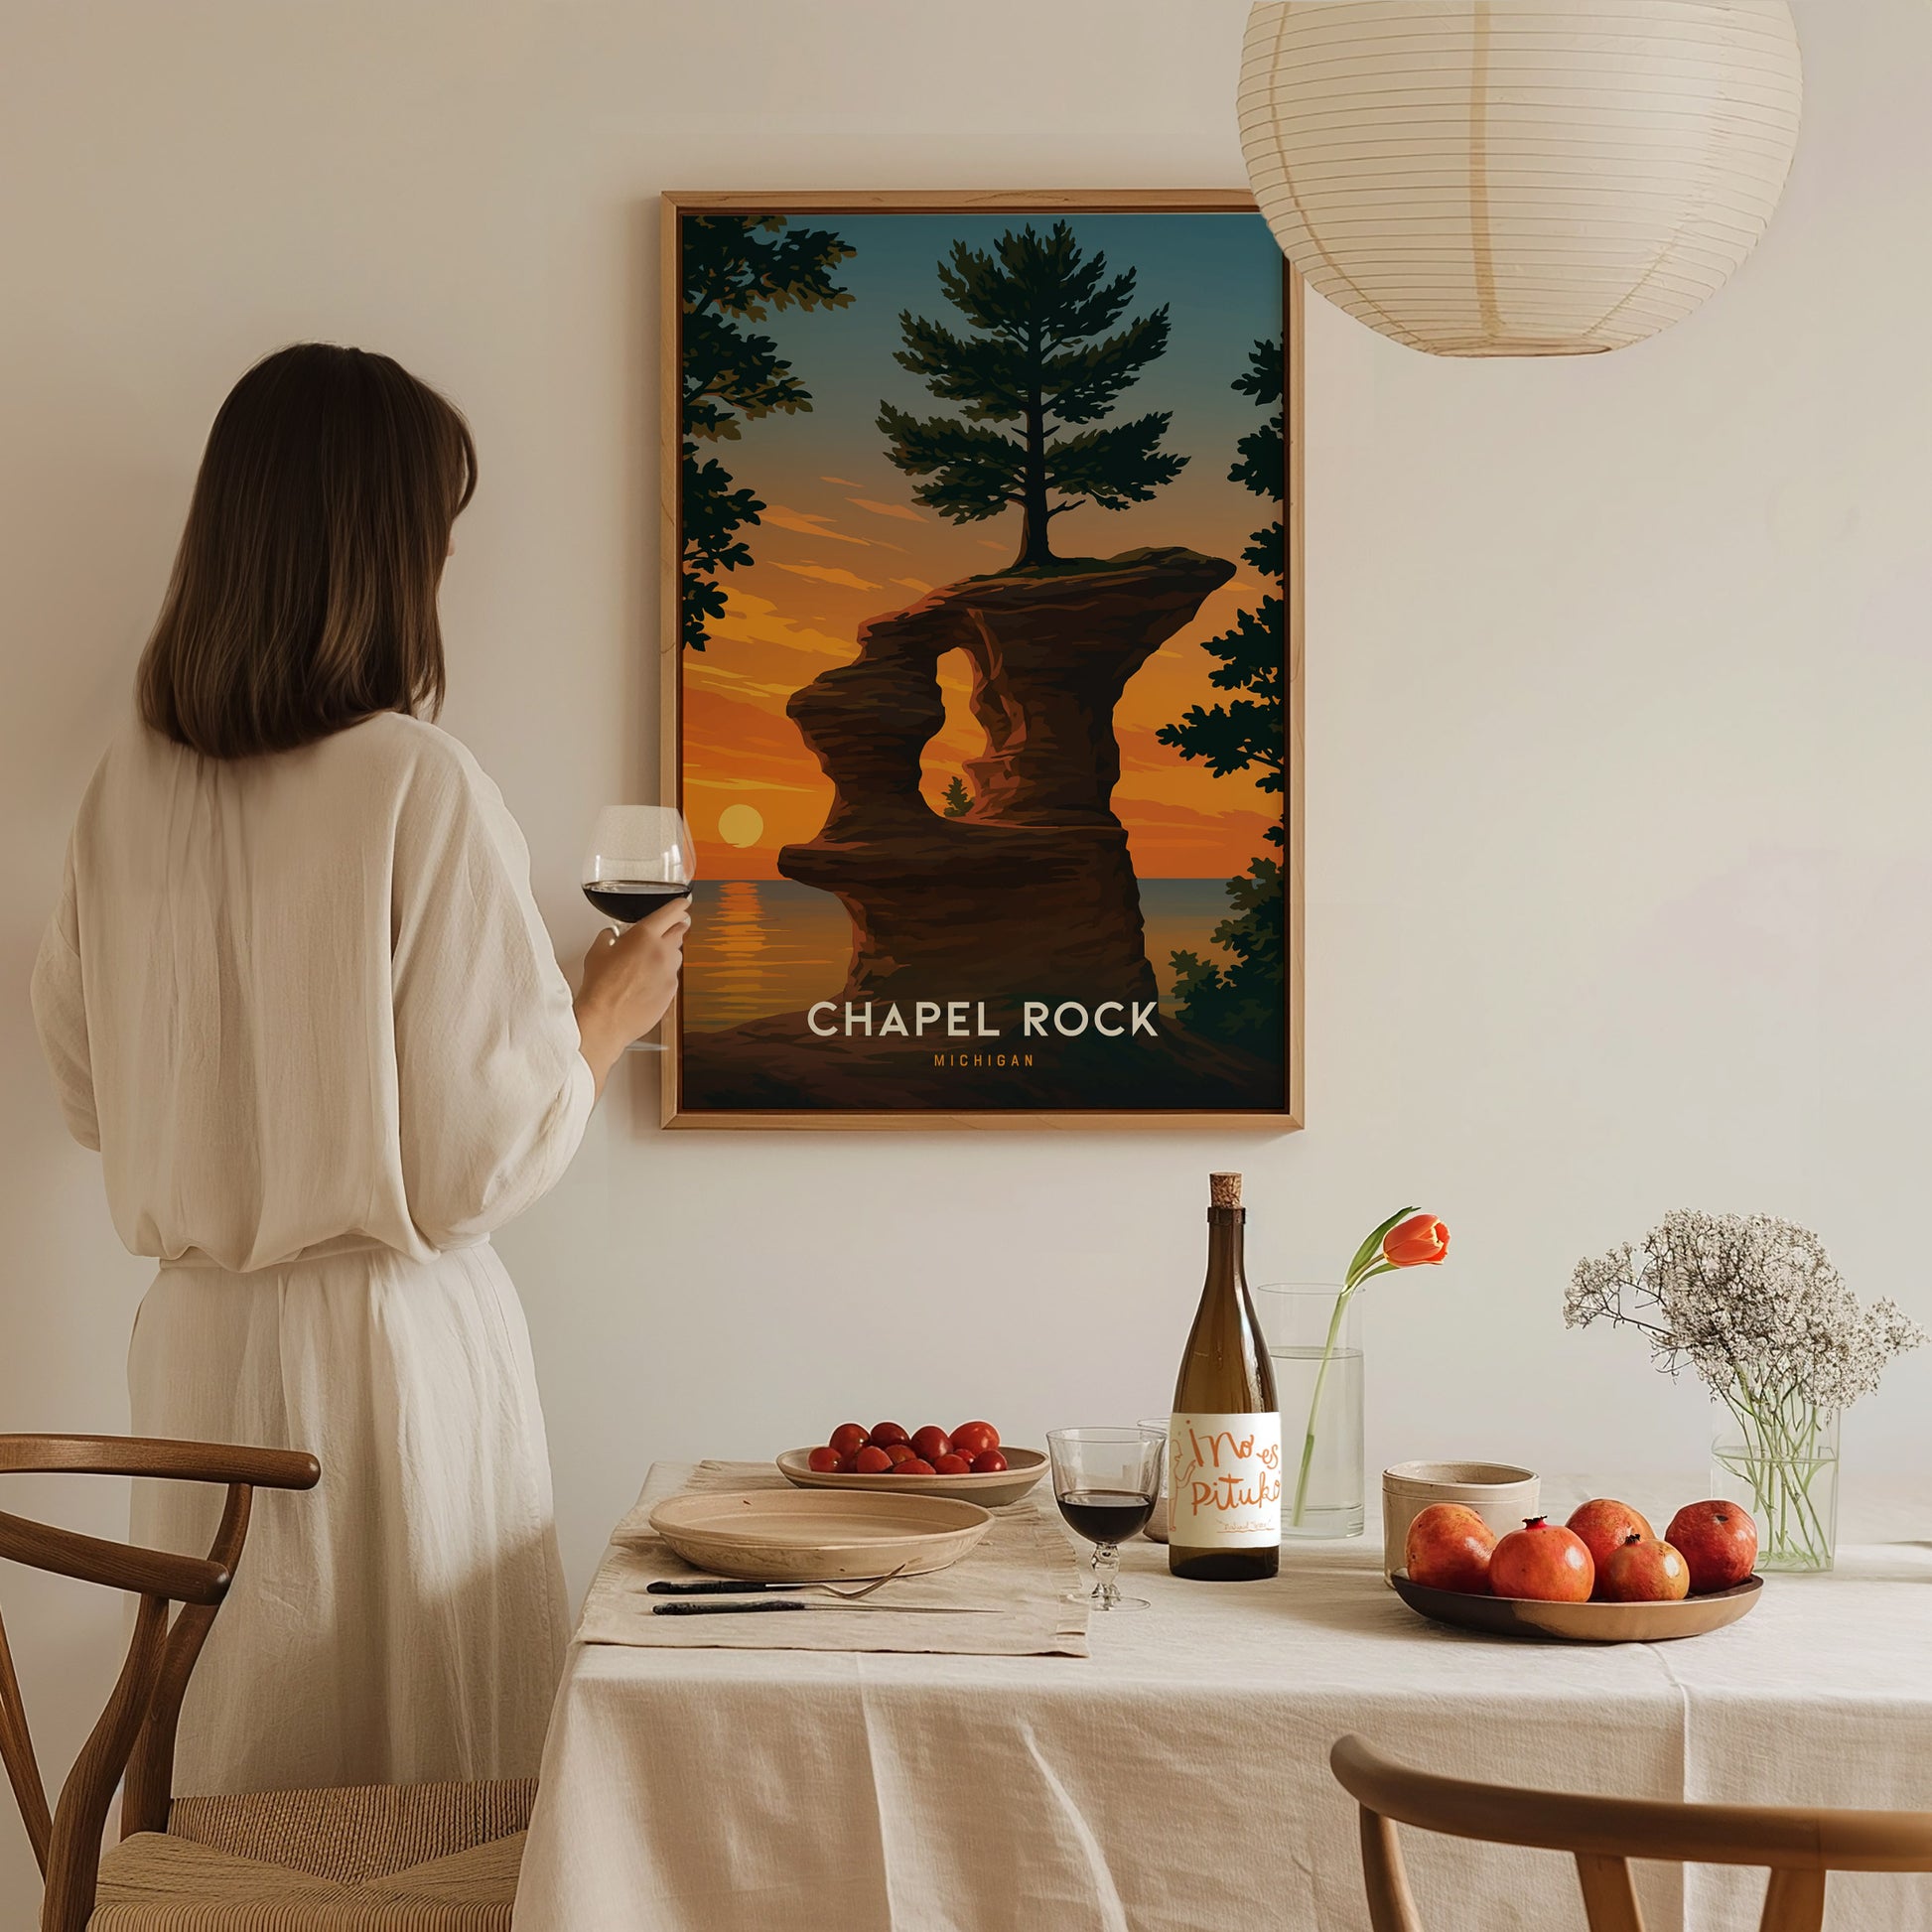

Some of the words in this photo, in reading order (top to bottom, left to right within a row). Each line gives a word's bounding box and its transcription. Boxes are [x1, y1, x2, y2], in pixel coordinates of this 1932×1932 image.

[807, 1001, 1001, 1036] CHAPEL
[1024, 1001, 1159, 1036] ROCK
[933, 1054, 1034, 1067] MICHIGAN
[1256, 1444, 1279, 1469] es
